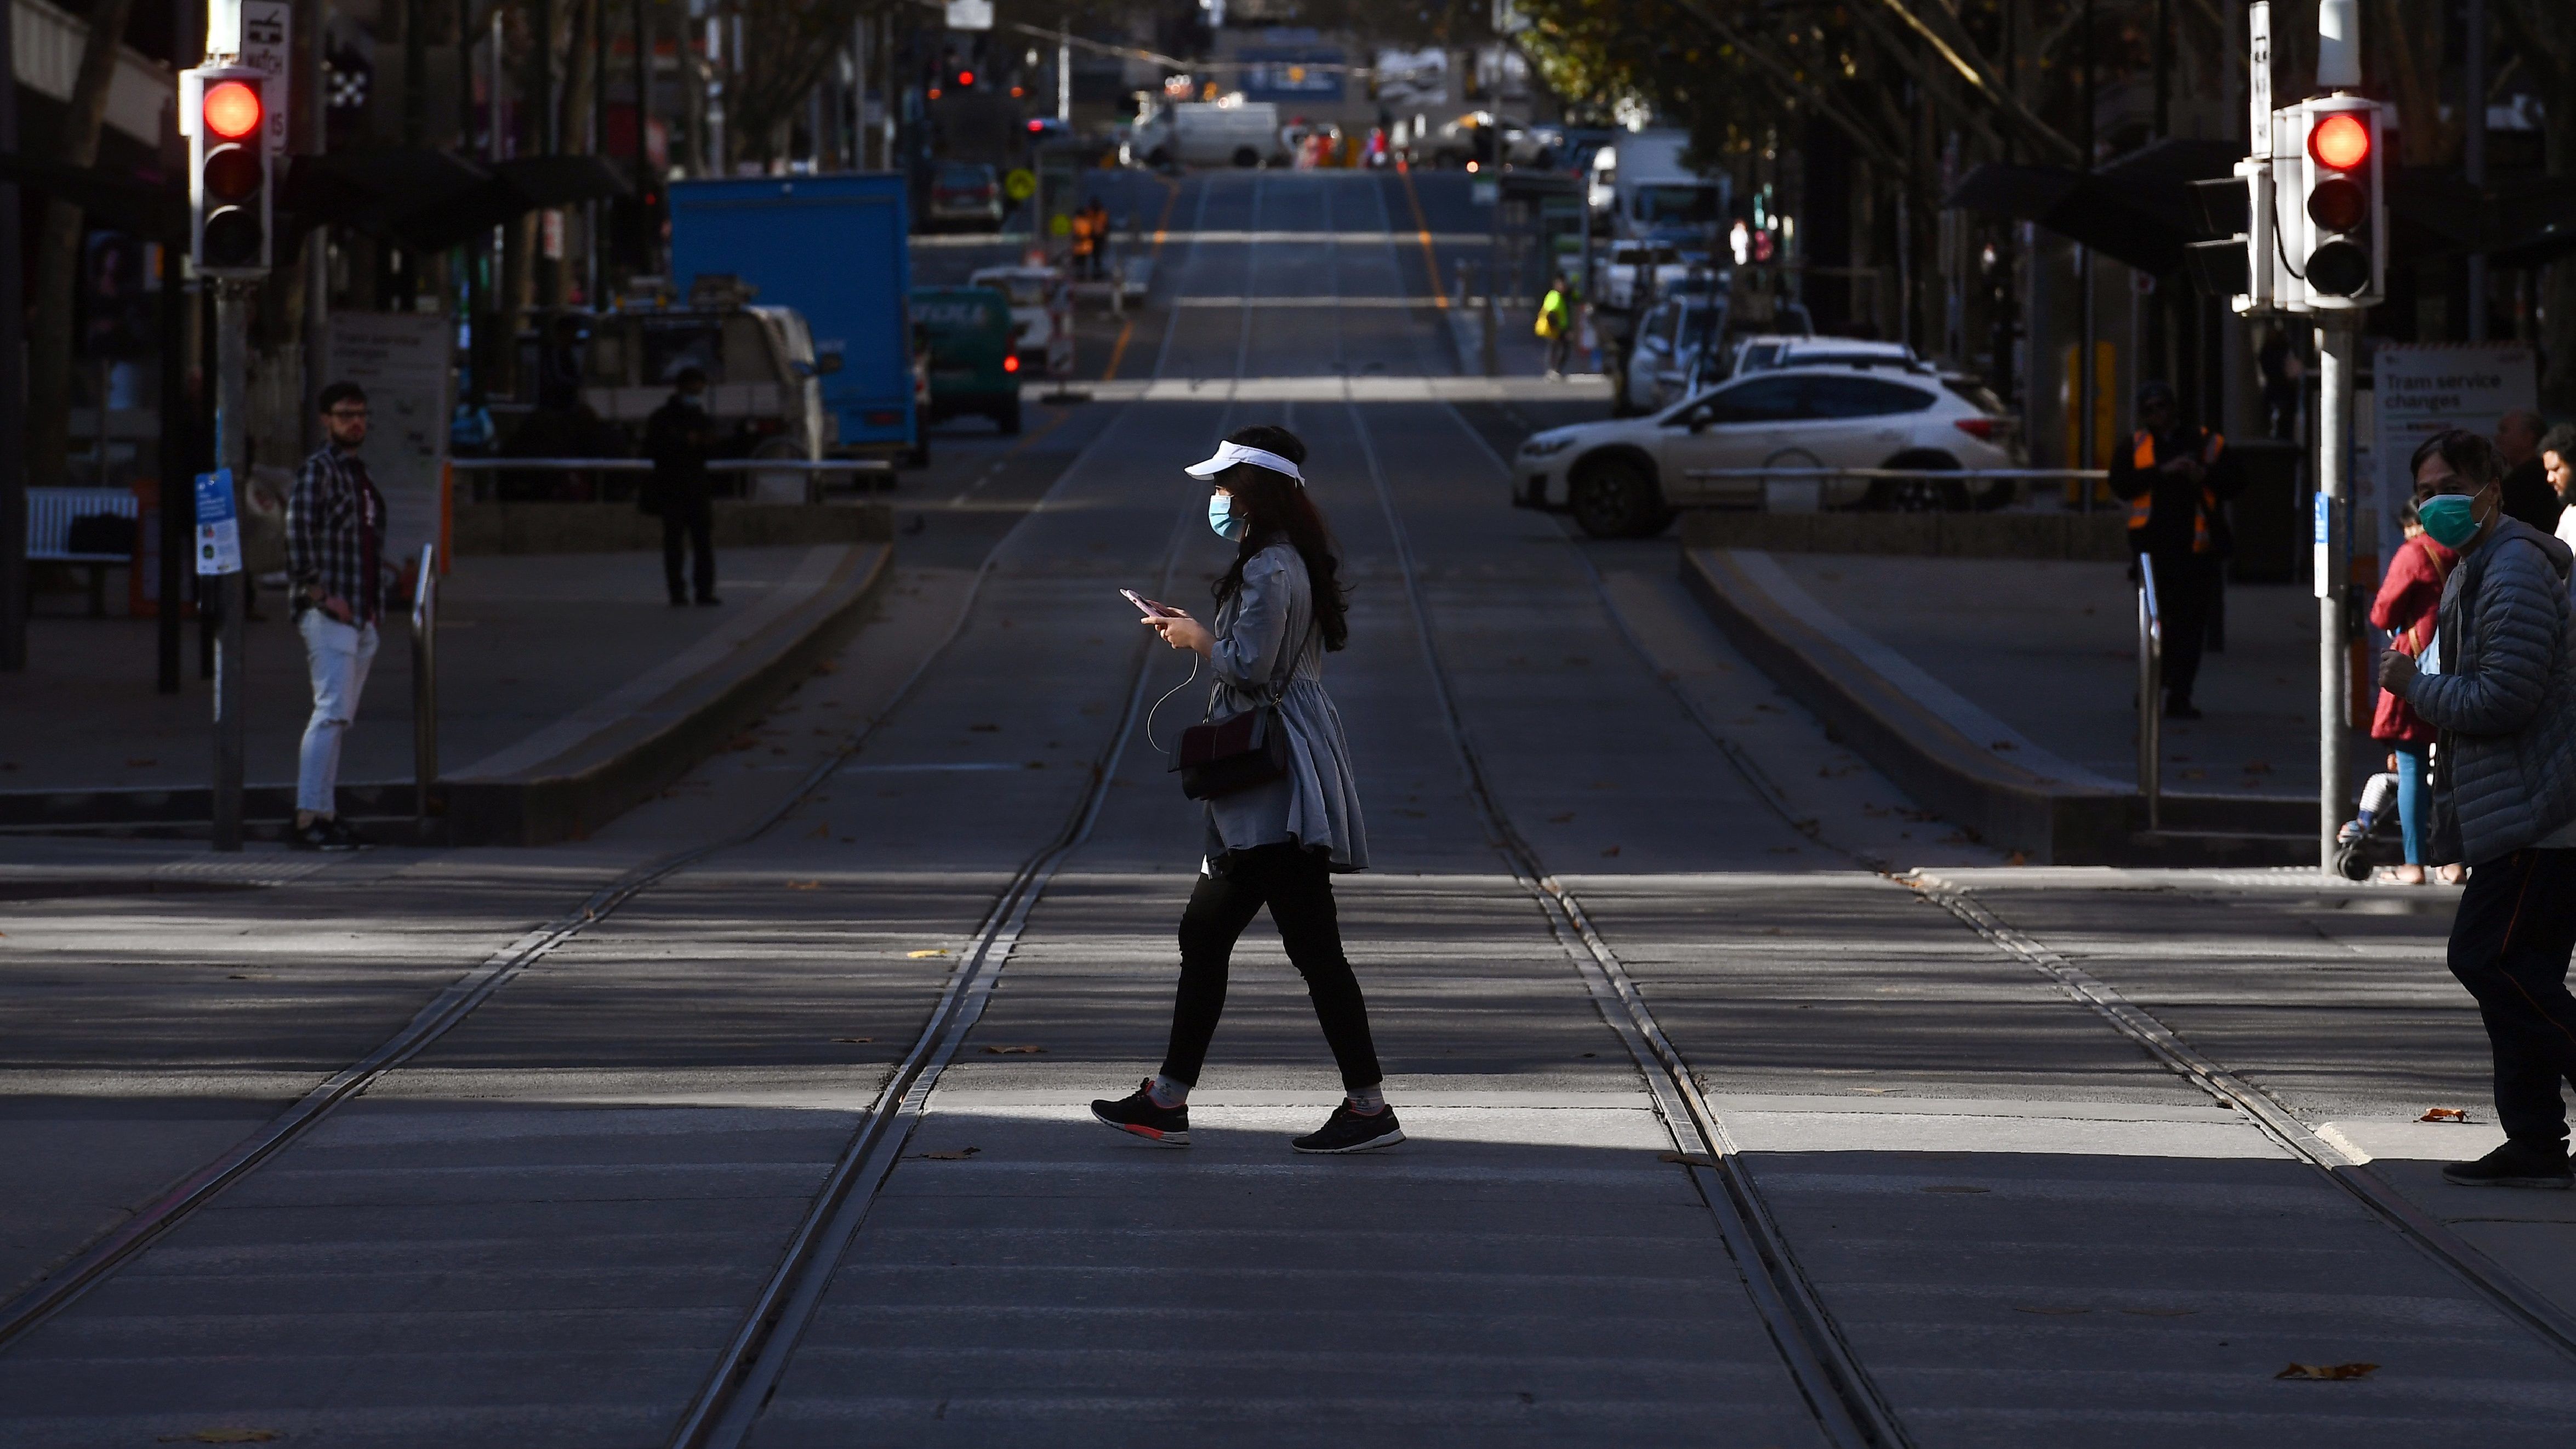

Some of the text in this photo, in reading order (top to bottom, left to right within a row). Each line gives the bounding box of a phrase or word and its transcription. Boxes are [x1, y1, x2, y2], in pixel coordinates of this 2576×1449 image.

[2387, 372, 2501, 389] Tram service
[2385, 394, 2460, 412] changes
